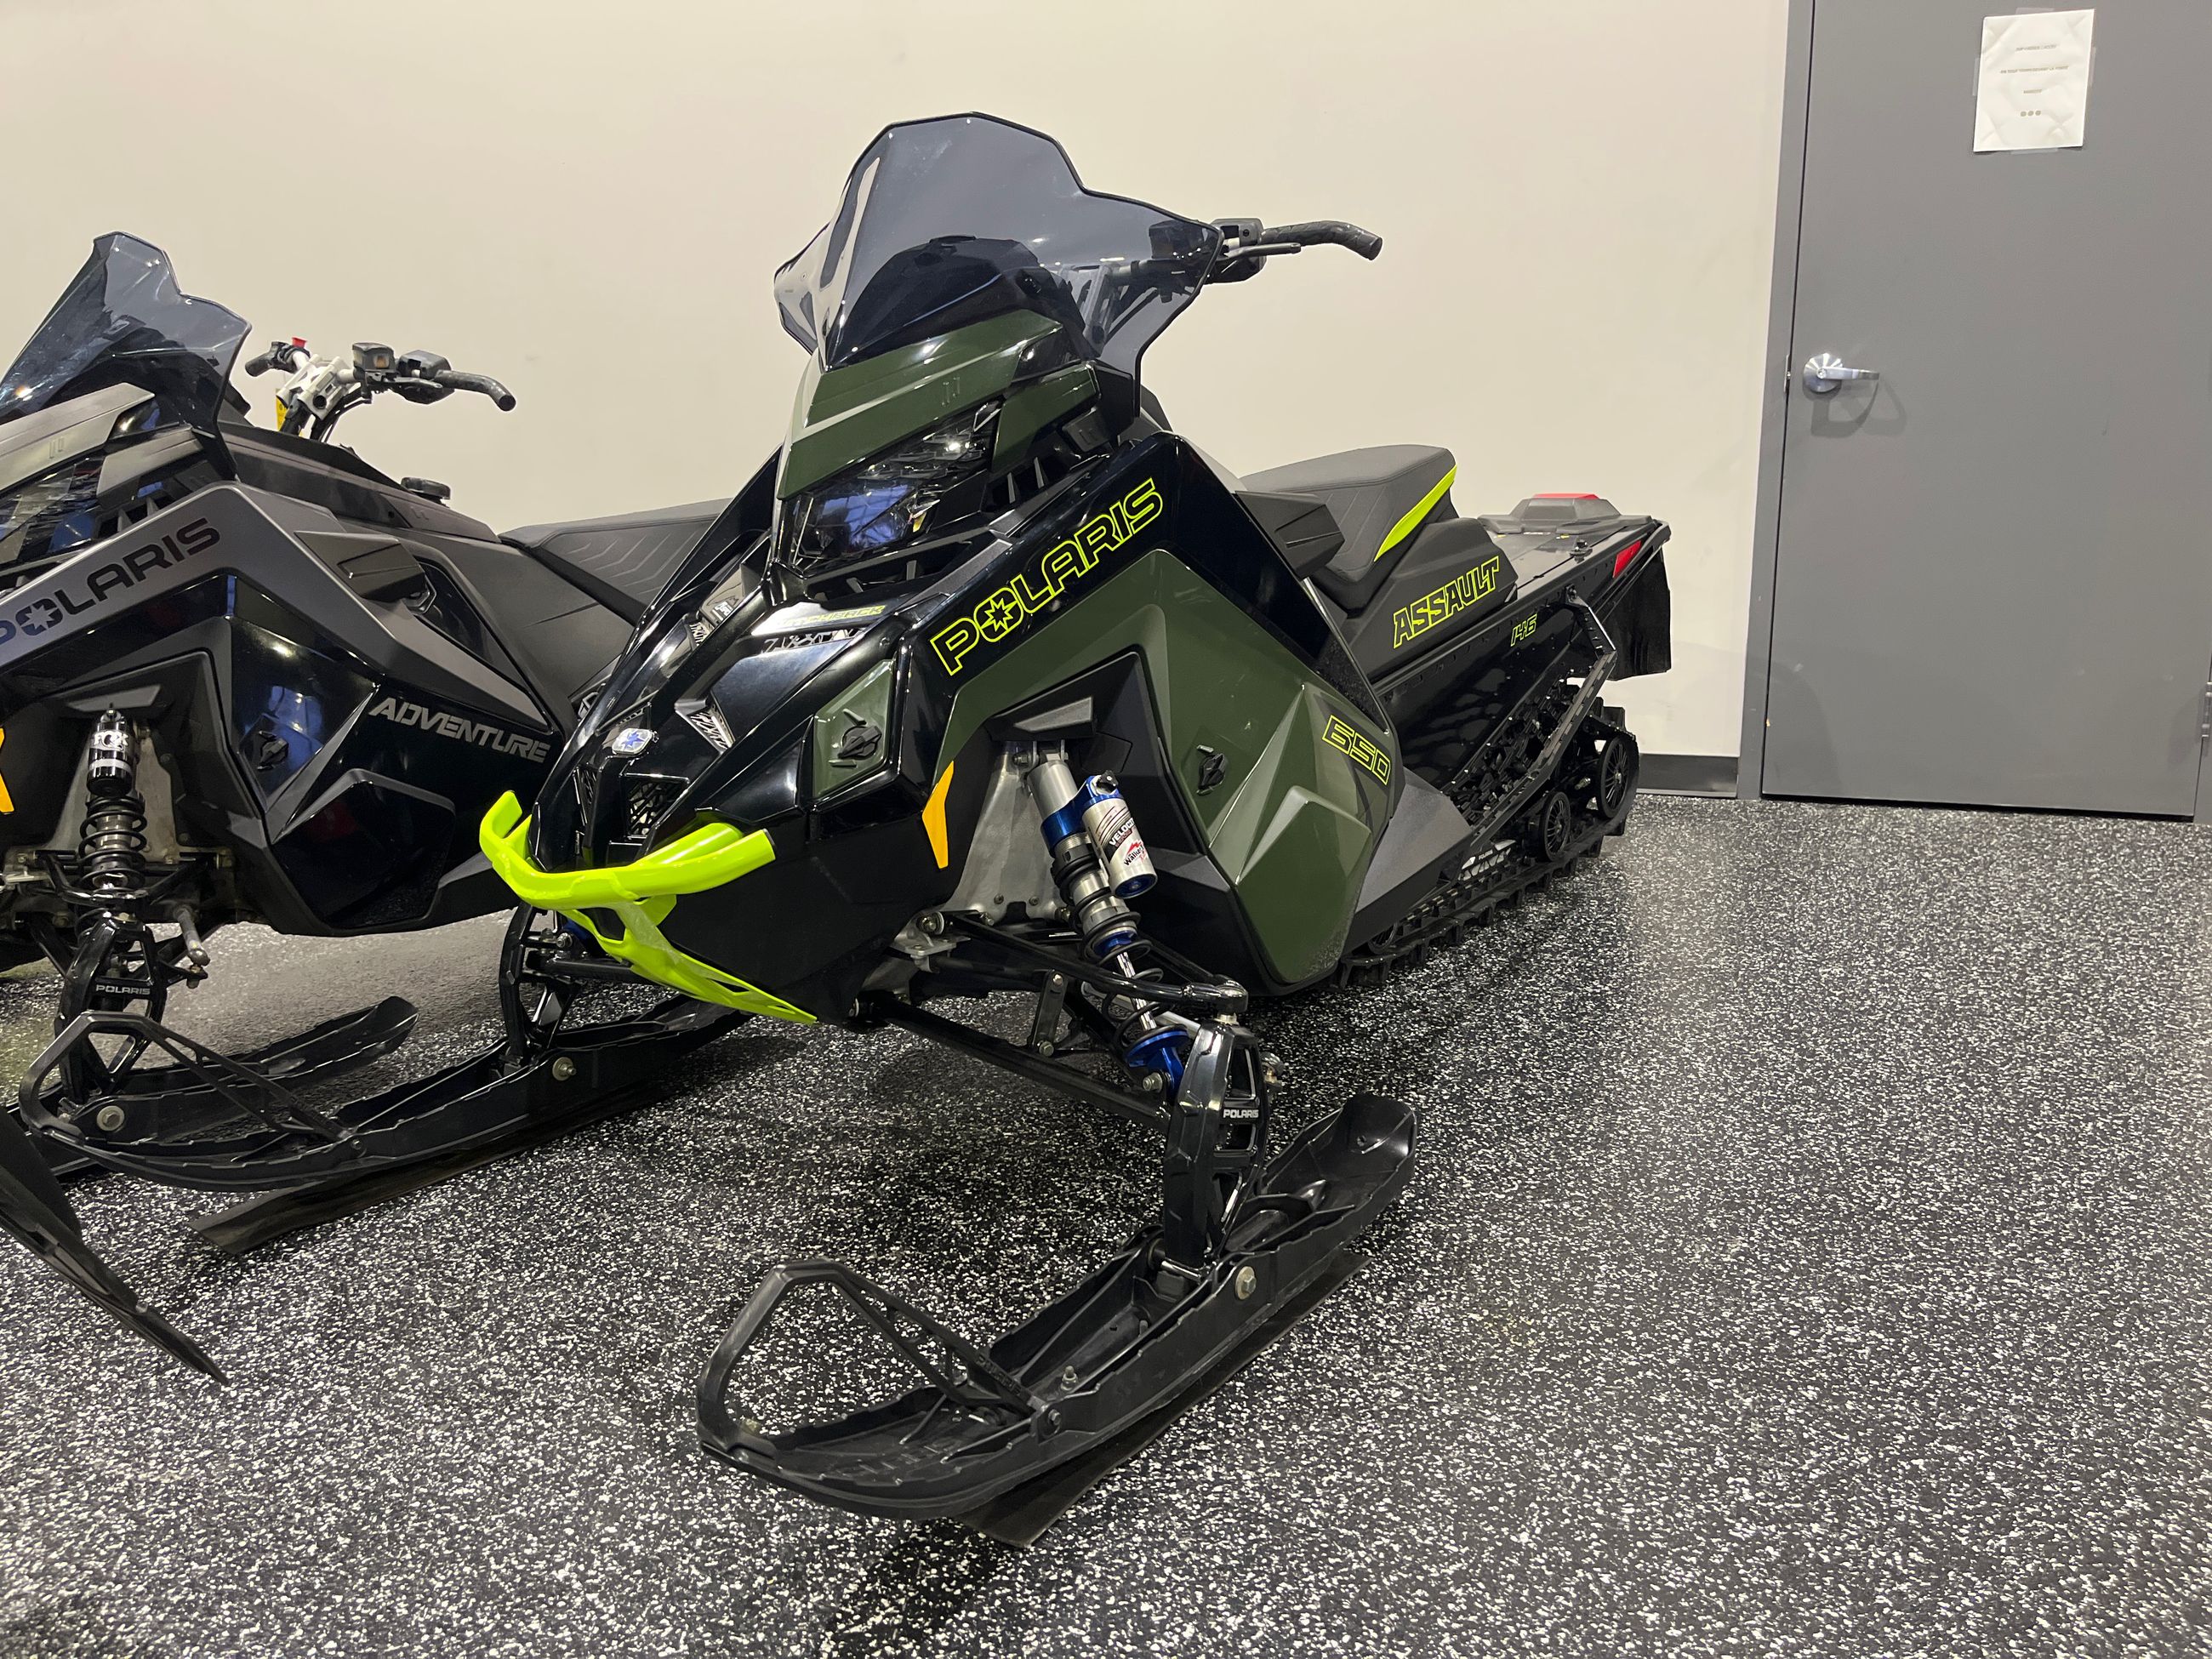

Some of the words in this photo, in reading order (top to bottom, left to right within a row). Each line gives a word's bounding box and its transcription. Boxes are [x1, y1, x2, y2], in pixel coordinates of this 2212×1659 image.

[930, 478, 1163, 676] POLARIS
[1394, 556, 1500, 648] ASSAULT
[1510, 613, 1538, 647] 146
[94, 730, 129, 750] FOX
[368, 697, 551, 763] ADVENTURE
[1321, 715, 1391, 785] 650
[95, 984, 151, 995] POLARIS
[1223, 1109, 1259, 1119] POLARIS
